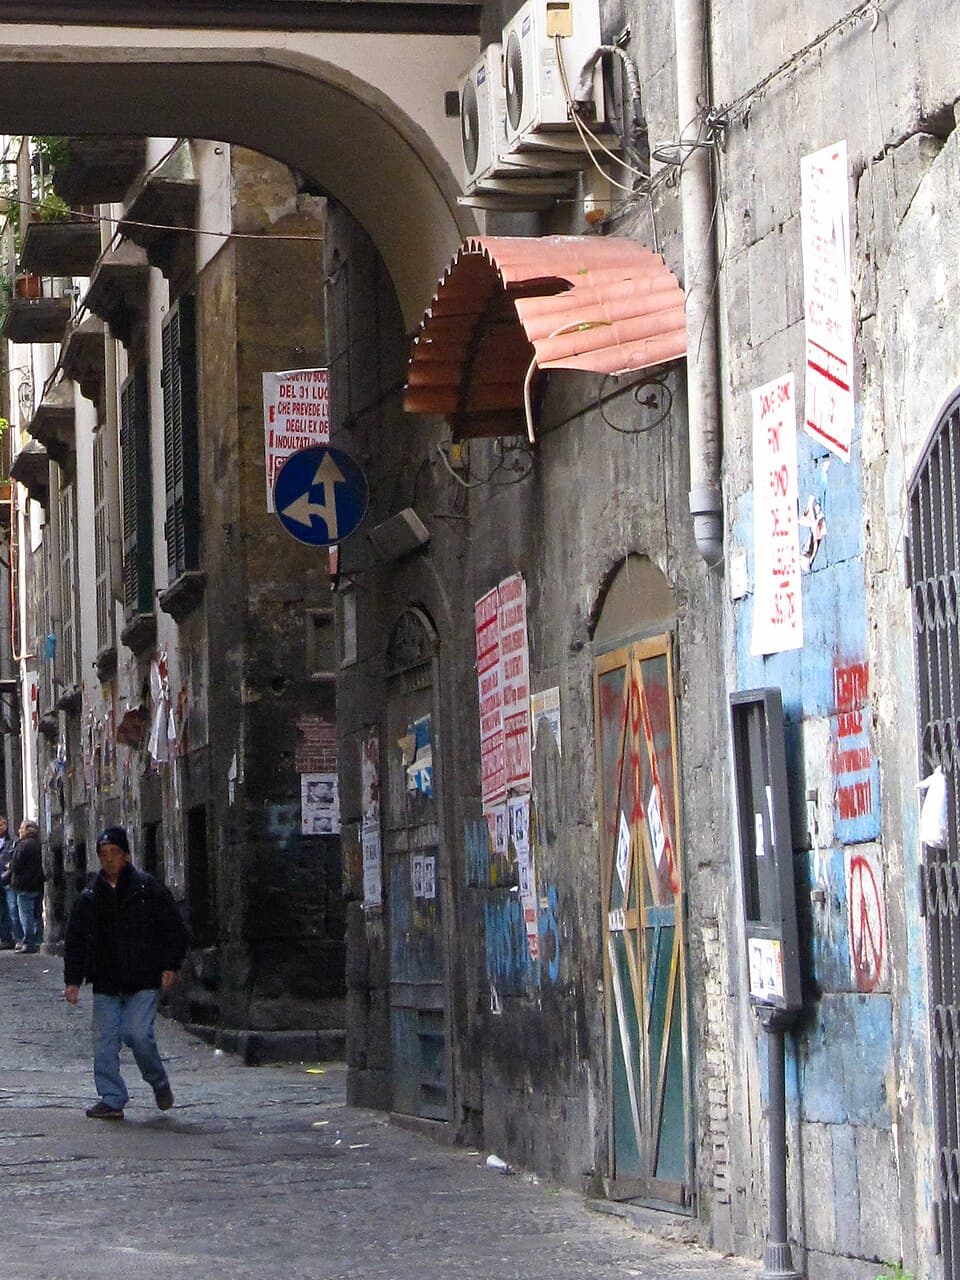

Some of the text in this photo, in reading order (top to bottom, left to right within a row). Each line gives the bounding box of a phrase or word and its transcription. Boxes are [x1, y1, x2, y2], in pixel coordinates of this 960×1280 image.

[280, 385, 296, 399] DEL
[300, 386, 309, 399] 31
[278, 401, 291, 415] CHE
[293, 402, 321, 417] PREVEDE
[286, 419, 307, 433] DEGLI
[309, 421, 317, 433] EX
